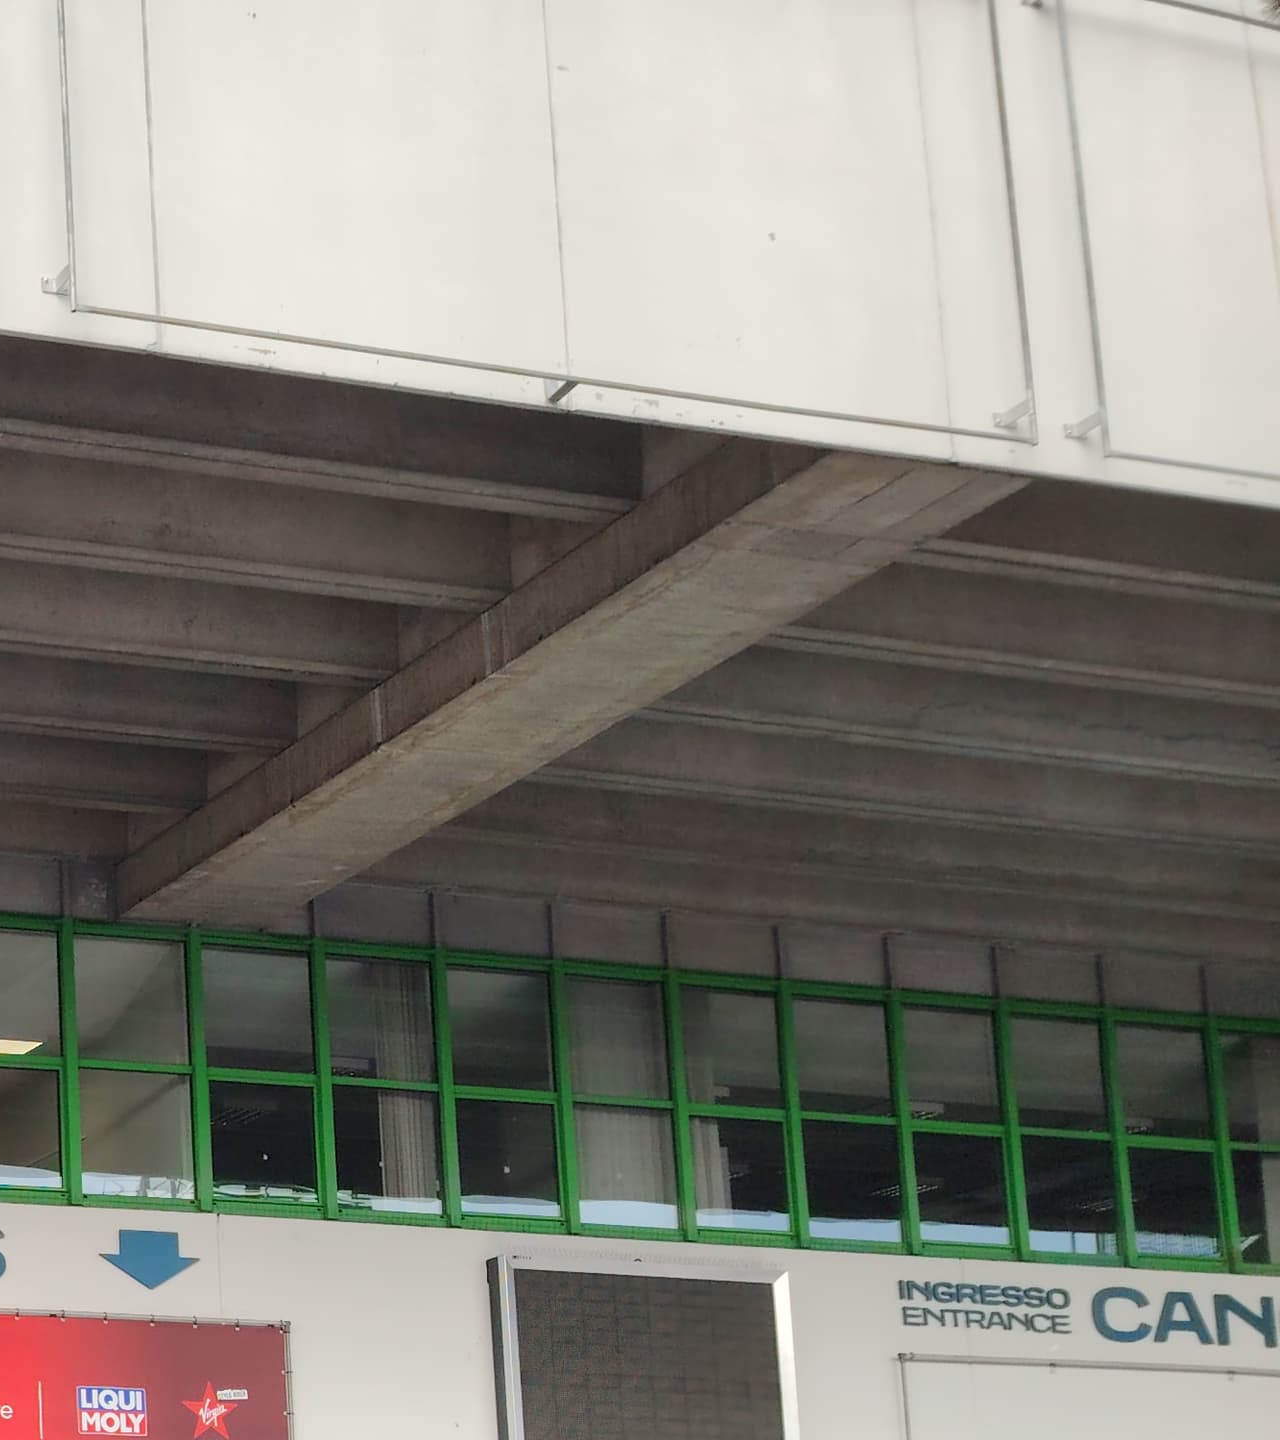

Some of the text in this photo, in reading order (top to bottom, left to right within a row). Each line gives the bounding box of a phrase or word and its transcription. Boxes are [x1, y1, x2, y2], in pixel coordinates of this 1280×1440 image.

[898, 1279, 1071, 1310] INGRESSO
[901, 1306, 1072, 1334] ENTRANCE
[1091, 1286, 1278, 1348] CAN
[80, 1388, 143, 1411] LIQUI
[81, 1411, 145, 1434] MOLY
